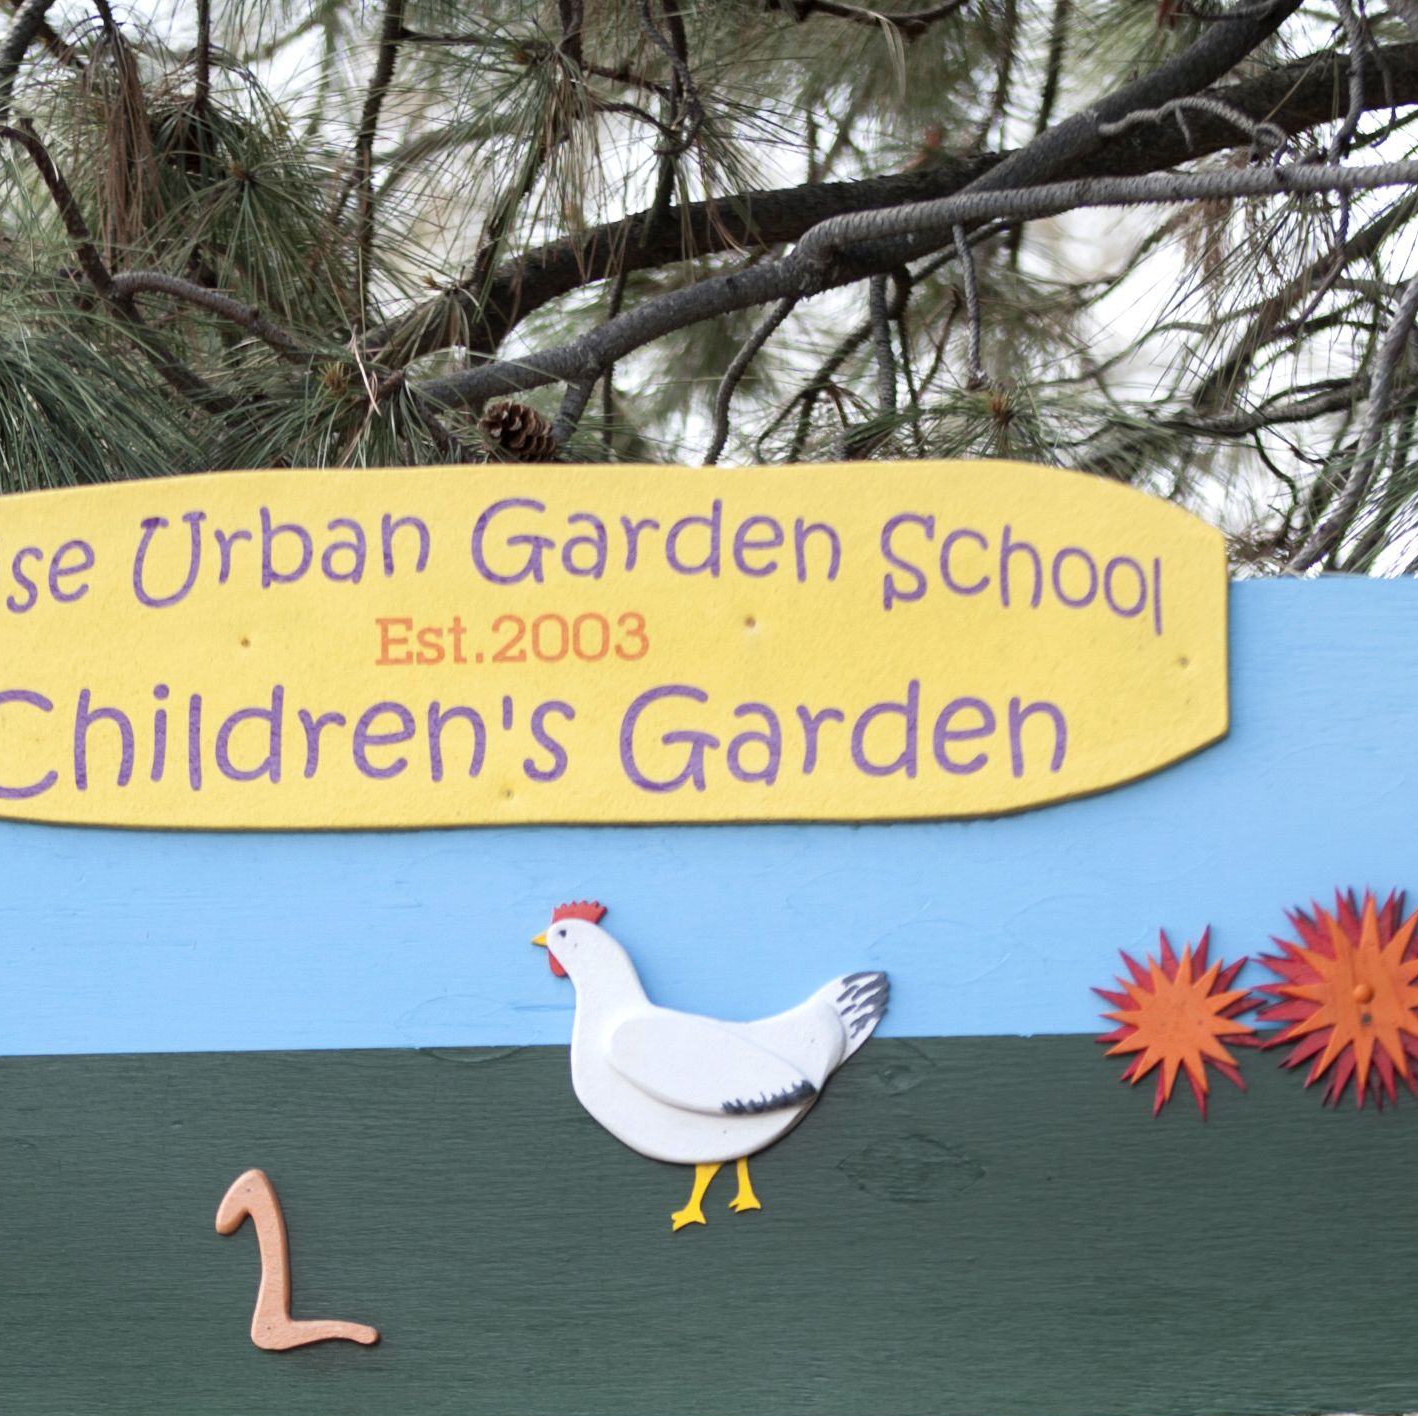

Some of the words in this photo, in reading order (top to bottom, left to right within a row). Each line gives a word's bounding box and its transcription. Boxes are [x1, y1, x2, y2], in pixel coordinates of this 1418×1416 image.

[133, 508, 430, 609] Urban
[472, 498, 841, 585] Garden
[881, 514, 1162, 635] School
[375, 614, 650, 666] Est.2003
[620, 680, 1068, 793] Garden
